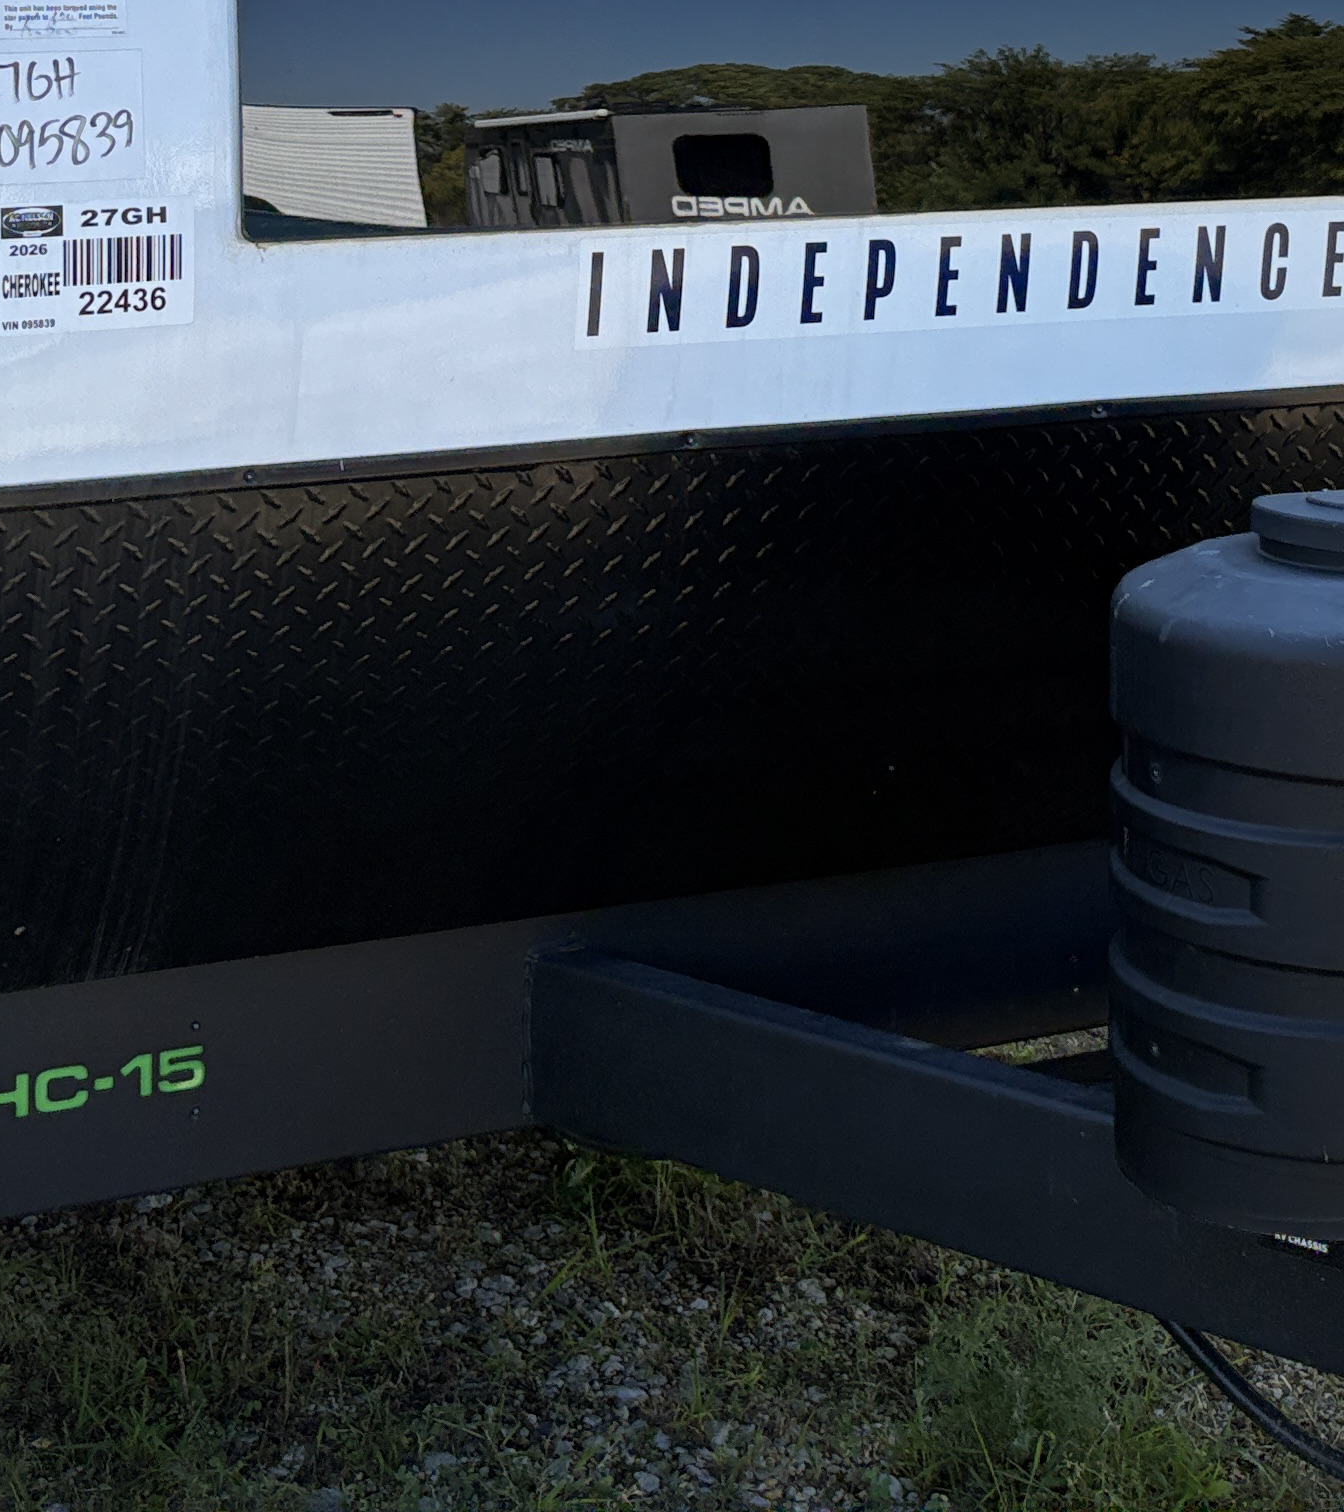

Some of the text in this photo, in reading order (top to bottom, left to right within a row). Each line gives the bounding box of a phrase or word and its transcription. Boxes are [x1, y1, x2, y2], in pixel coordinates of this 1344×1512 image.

[80, 206, 168, 228] 27GH
[9, 243, 48, 257] 2026
[2, 272, 61, 299] CHEROKEE
[78, 287, 167, 316] 22436
[2, 320, 19, 331] VIN
[1287, 1235, 1329, 1254] CHASSIS
